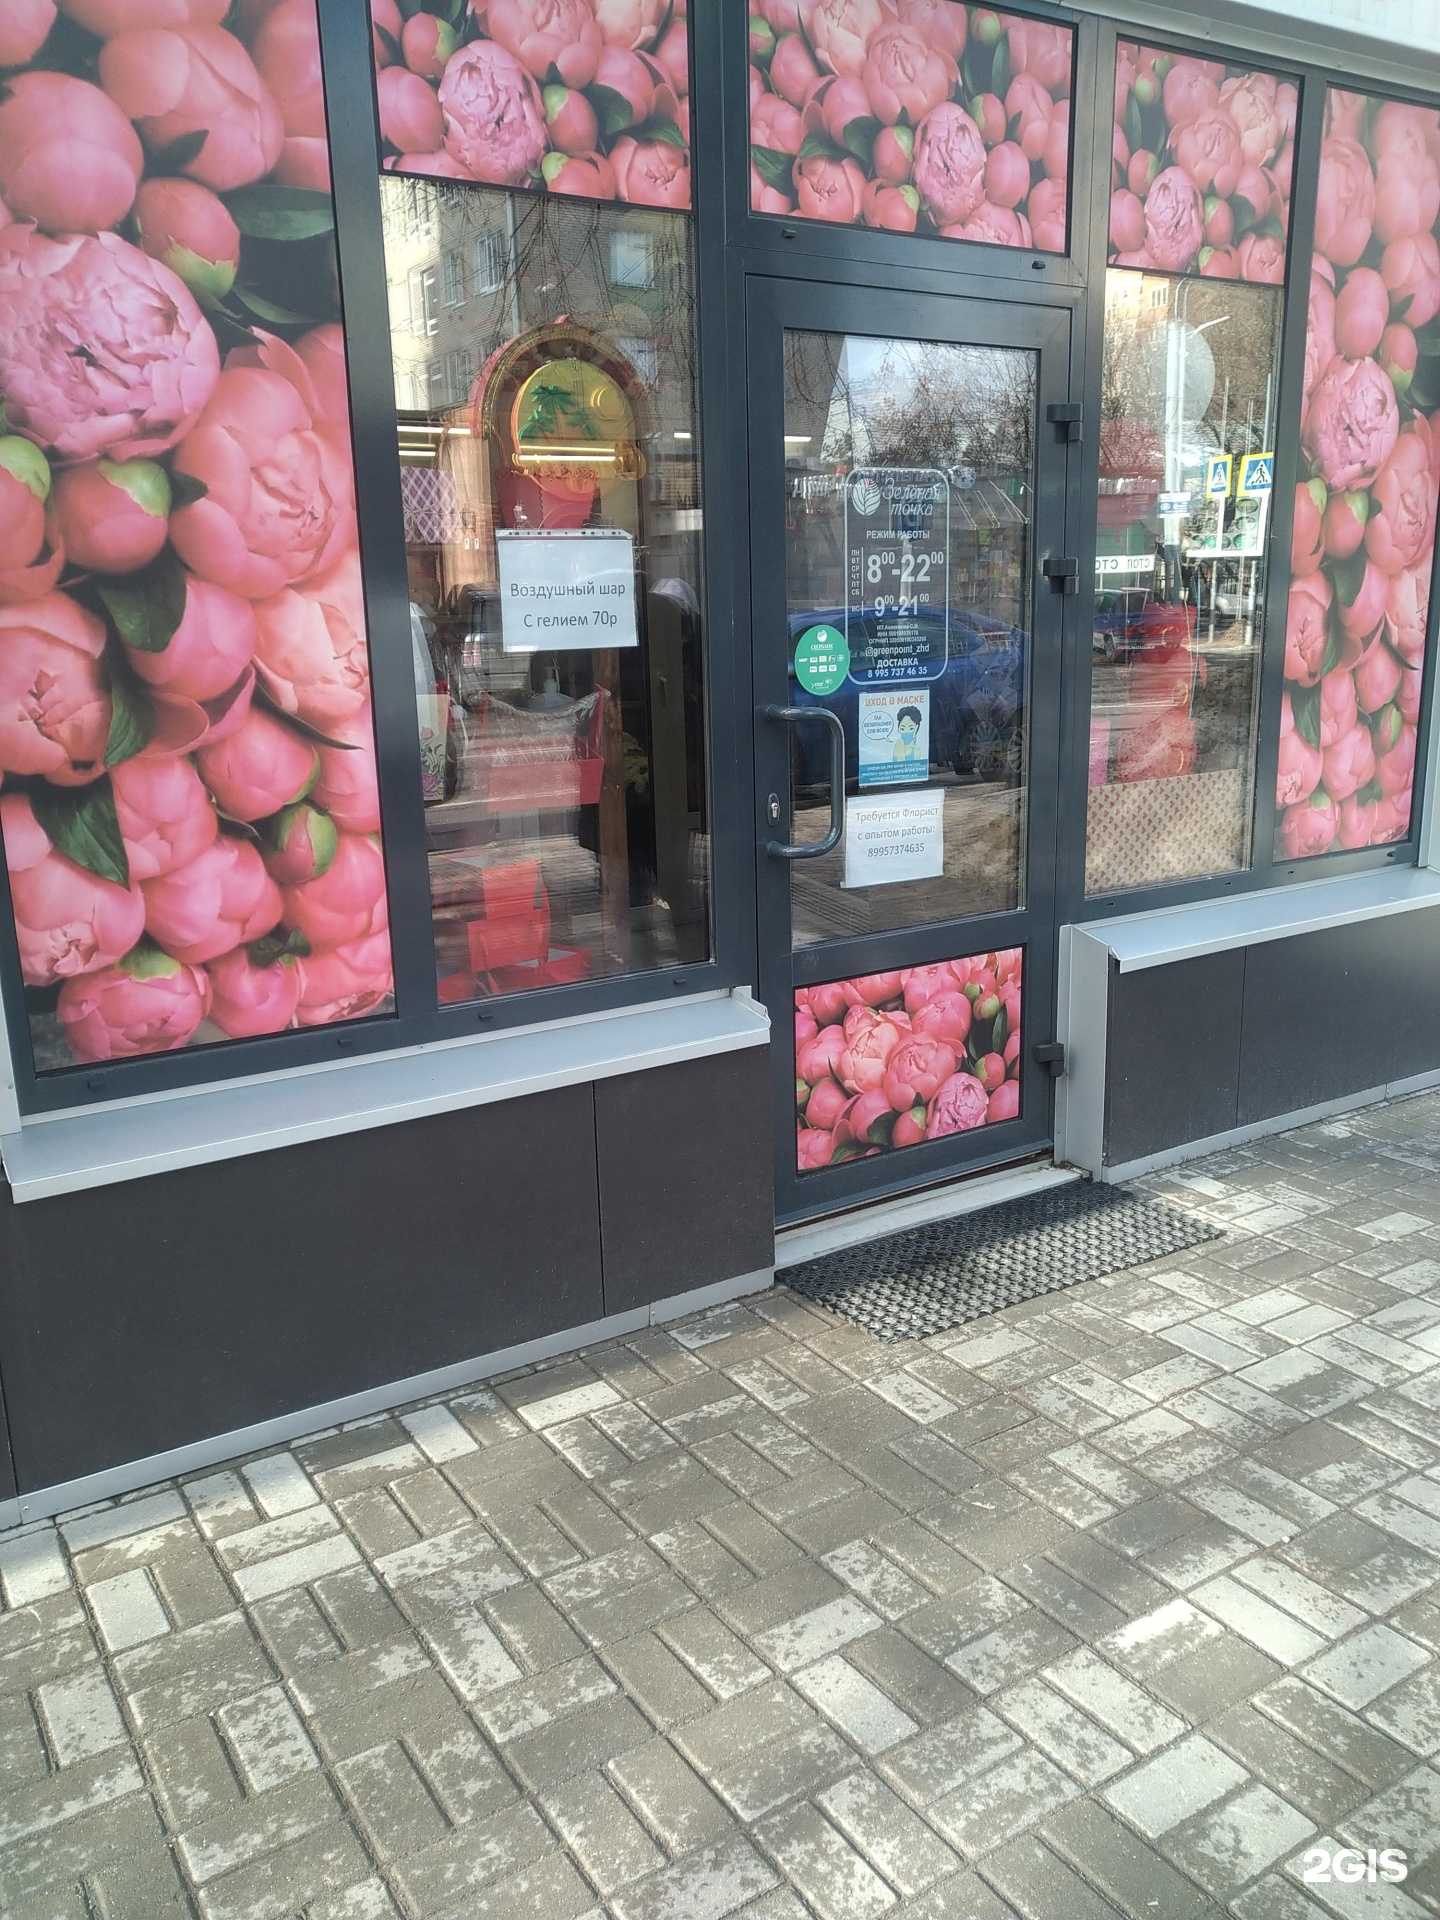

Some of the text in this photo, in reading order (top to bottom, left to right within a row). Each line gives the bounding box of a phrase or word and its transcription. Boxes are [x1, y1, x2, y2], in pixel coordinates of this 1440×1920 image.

[890, 503, 933, 516] точка
[866, 530, 930, 540] РЕЖИМ РАБОТЫ
[510, 581, 626, 600] Воздушный шар
[851, 588, 860, 596] СБ
[523, 610, 618, 628] С гелием 70р
[876, 657, 919, 669] ДОСТАВКА
[867, 666, 928, 678] 8 995 737 46 35
[856, 807, 939, 824] Требуется Флорист
[857, 832, 863, 840] с
[864, 830, 900, 840] опытом
[867, 842, 925, 857] 89957374635
